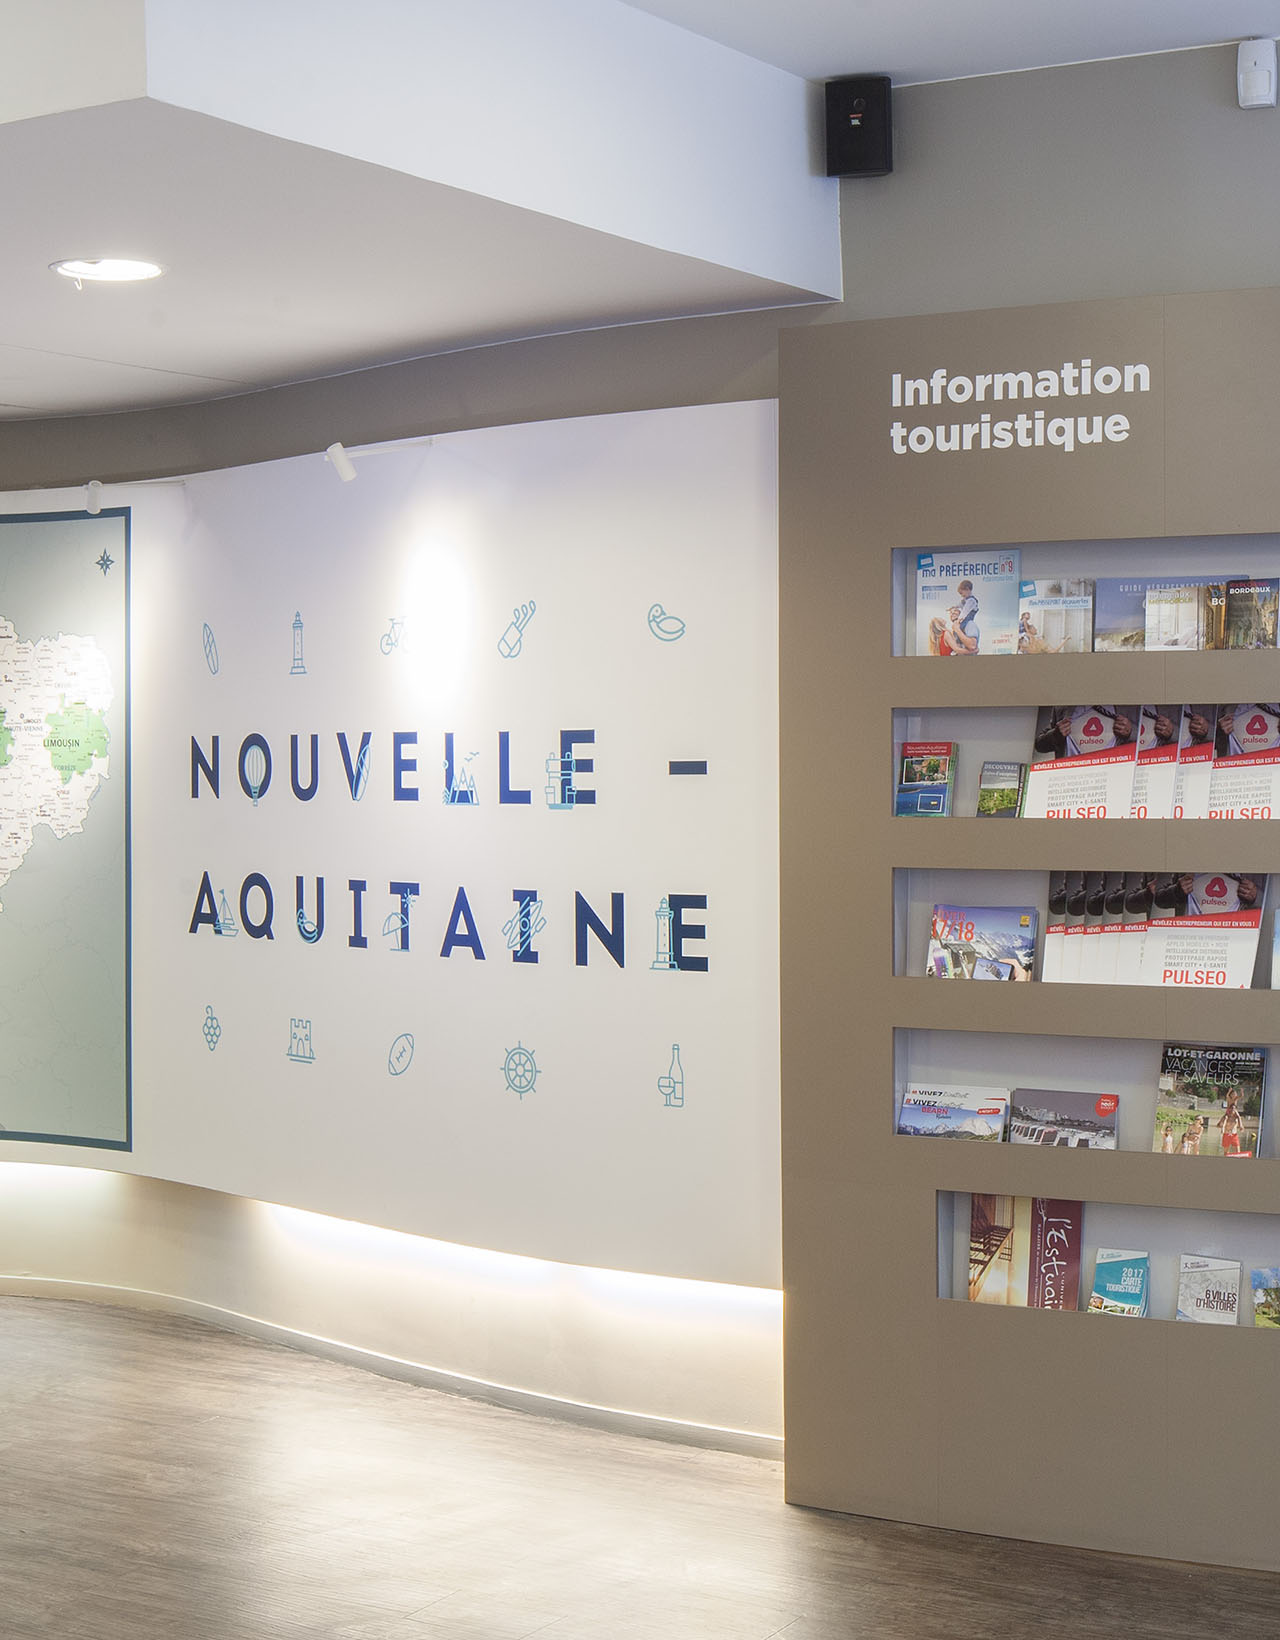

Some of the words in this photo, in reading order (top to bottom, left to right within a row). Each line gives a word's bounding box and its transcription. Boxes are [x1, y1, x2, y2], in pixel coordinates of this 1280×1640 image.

[891, 358, 1151, 408] Information
[890, 410, 1130, 455] touristique
[939, 561, 999, 577] PRÉFÉRENCE
[43, 739, 80, 747] LIMOUSIN
[1080, 737, 1105, 745] pulseo
[1242, 736, 1269, 745] pulseo
[190, 729, 597, 806] NOUVELLE
[1046, 805, 1107, 819] PULSEO
[1208, 806, 1271, 819] PULSEO
[1201, 898, 1227, 906] pulseo
[189, 870, 709, 973] AQUITAINE
[932, 919, 975, 942] 17/18
[1162, 969, 1227, 986] PULSEO
[1166, 1057, 1232, 1073] VACANCES
[1165, 1069, 1181, 1081] ET
[1183, 1070, 1239, 1086] SAVEURS
[1122, 1267, 1143, 1278] 2017
[1106, 1283, 1141, 1294] TOURISTIQUE
[1121, 1276, 1142, 1287] CARTE
[1205, 1289, 1211, 1300] 6
[1212, 1289, 1237, 1302] VILLES
[1195, 1297, 1237, 1313] D'HISTOIRE
